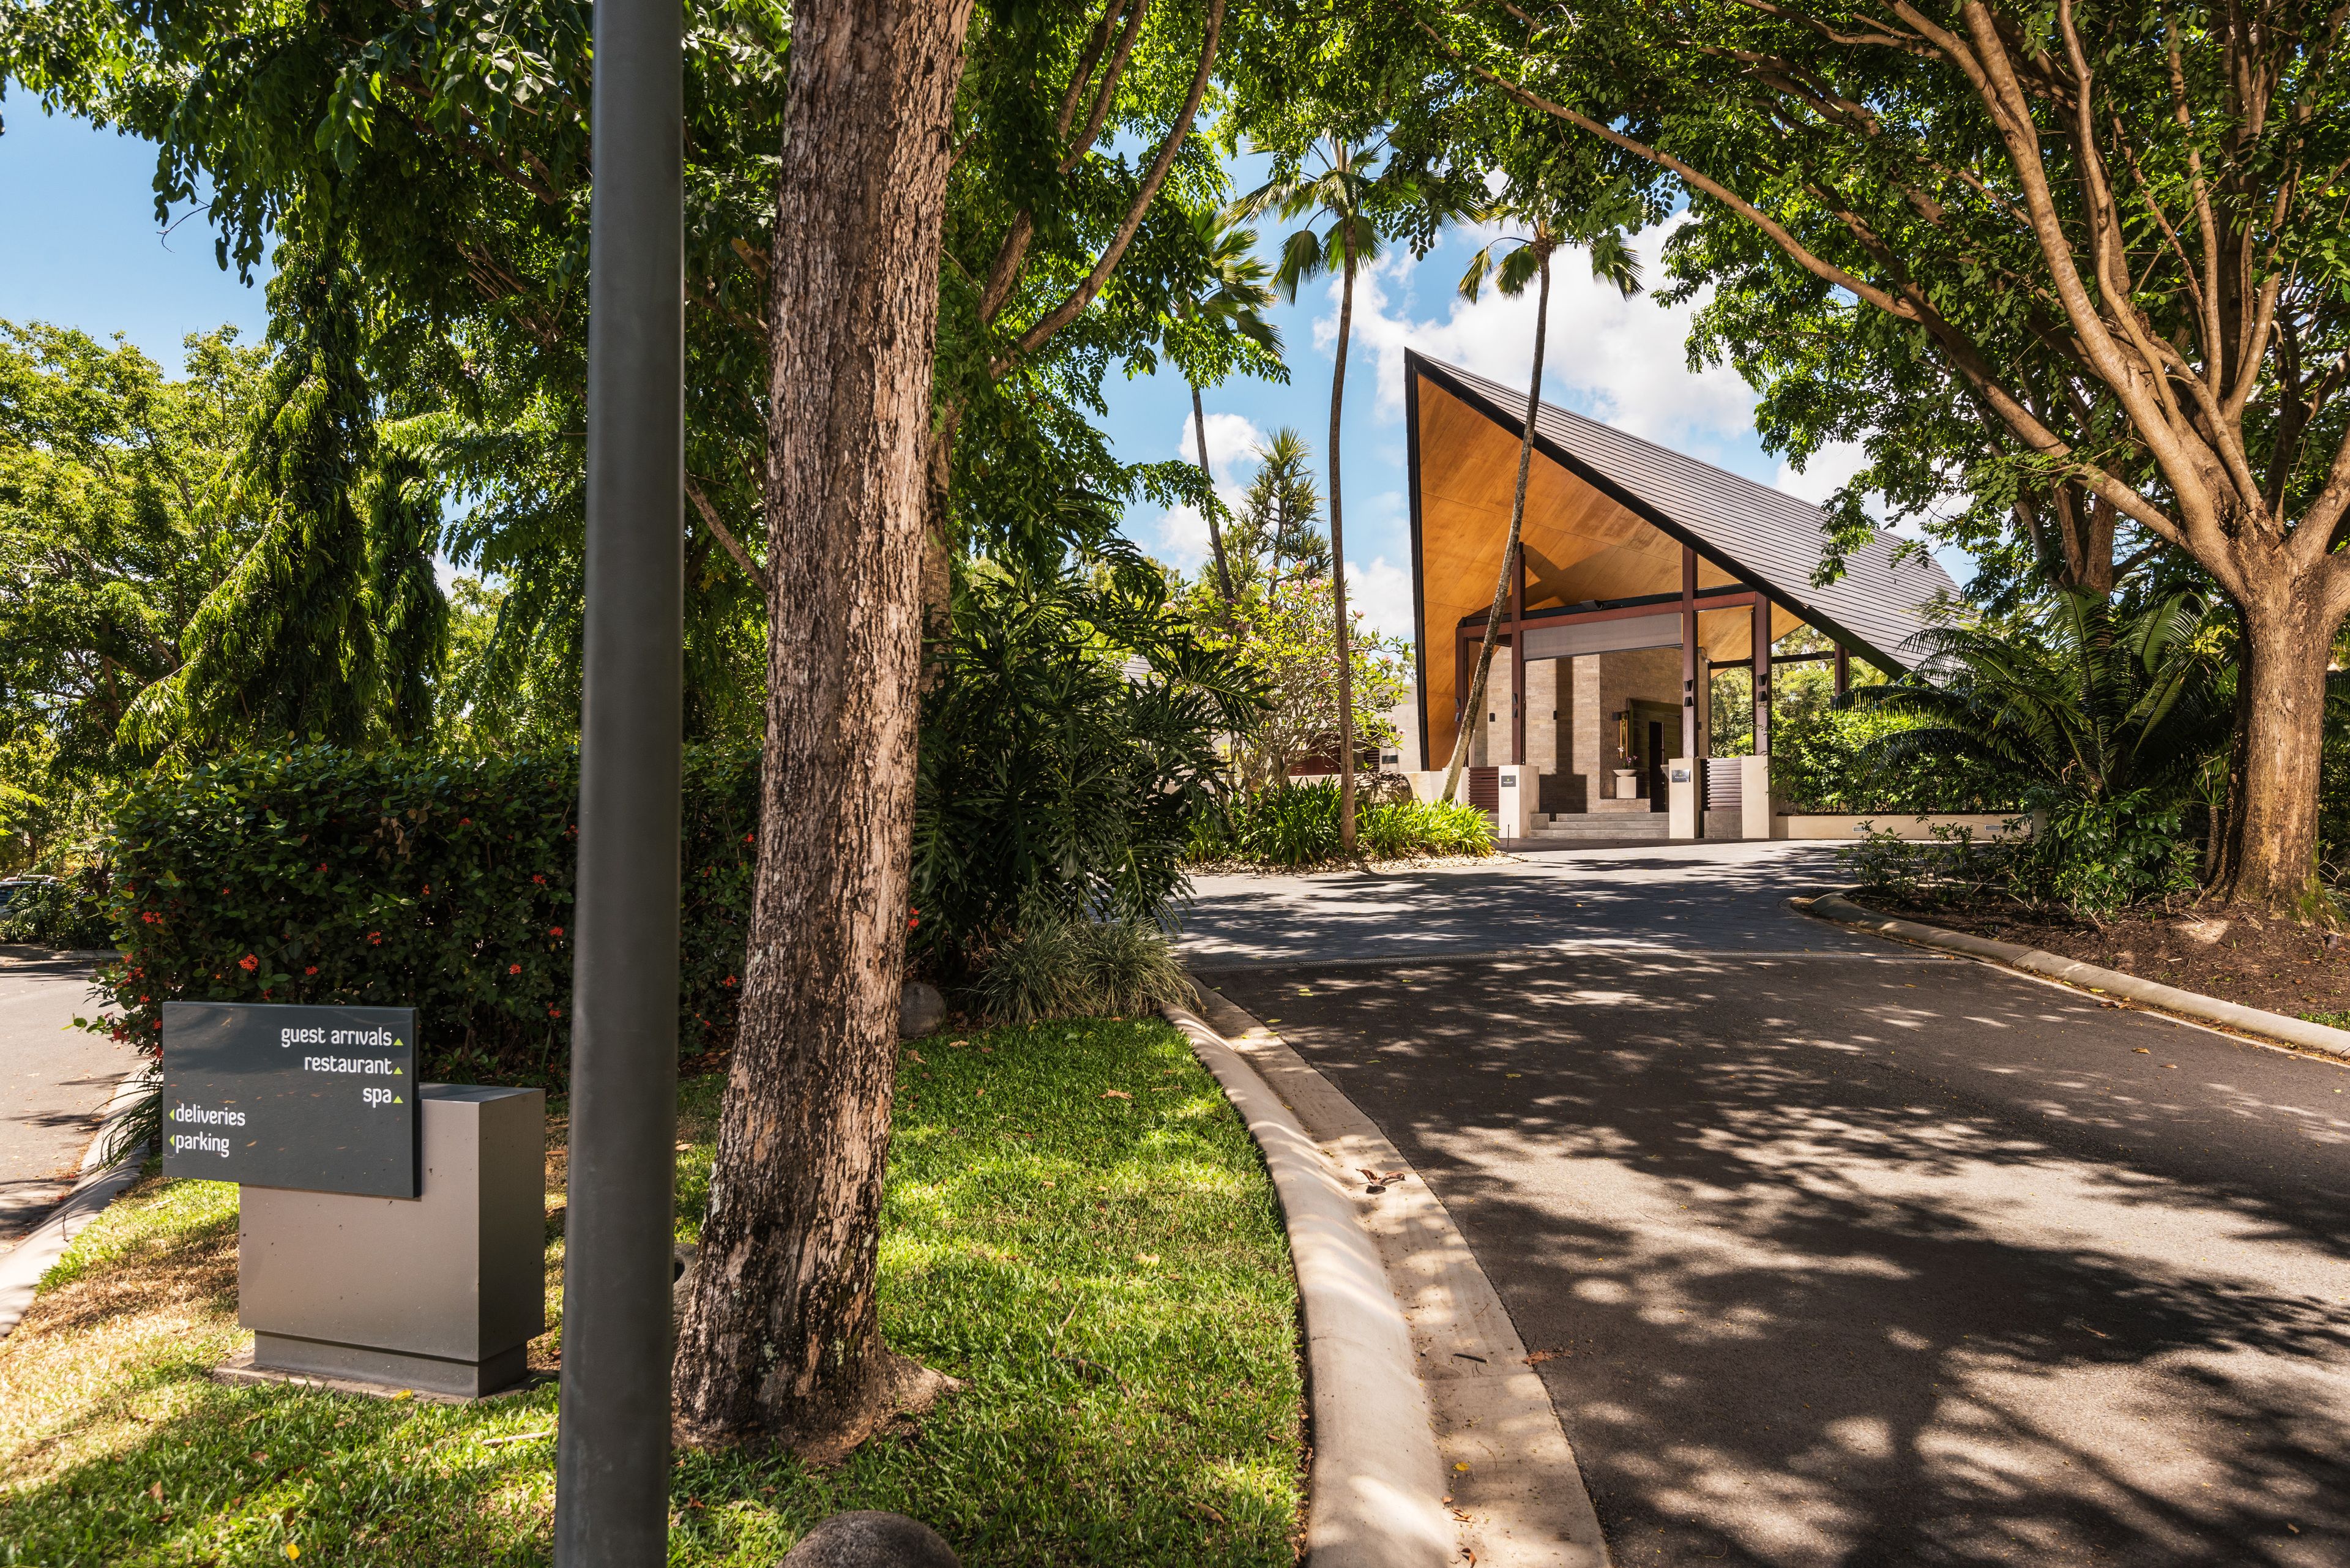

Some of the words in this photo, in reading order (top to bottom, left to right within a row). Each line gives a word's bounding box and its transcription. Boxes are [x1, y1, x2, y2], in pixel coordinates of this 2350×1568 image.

[281, 1027, 326, 1048] guest
[330, 1026, 392, 1047] arrivals
[304, 1055, 393, 1075] restaurant
[362, 1087, 392, 1108] spa
[176, 1103, 246, 1127] deliveries
[176, 1131, 229, 1158] parking
